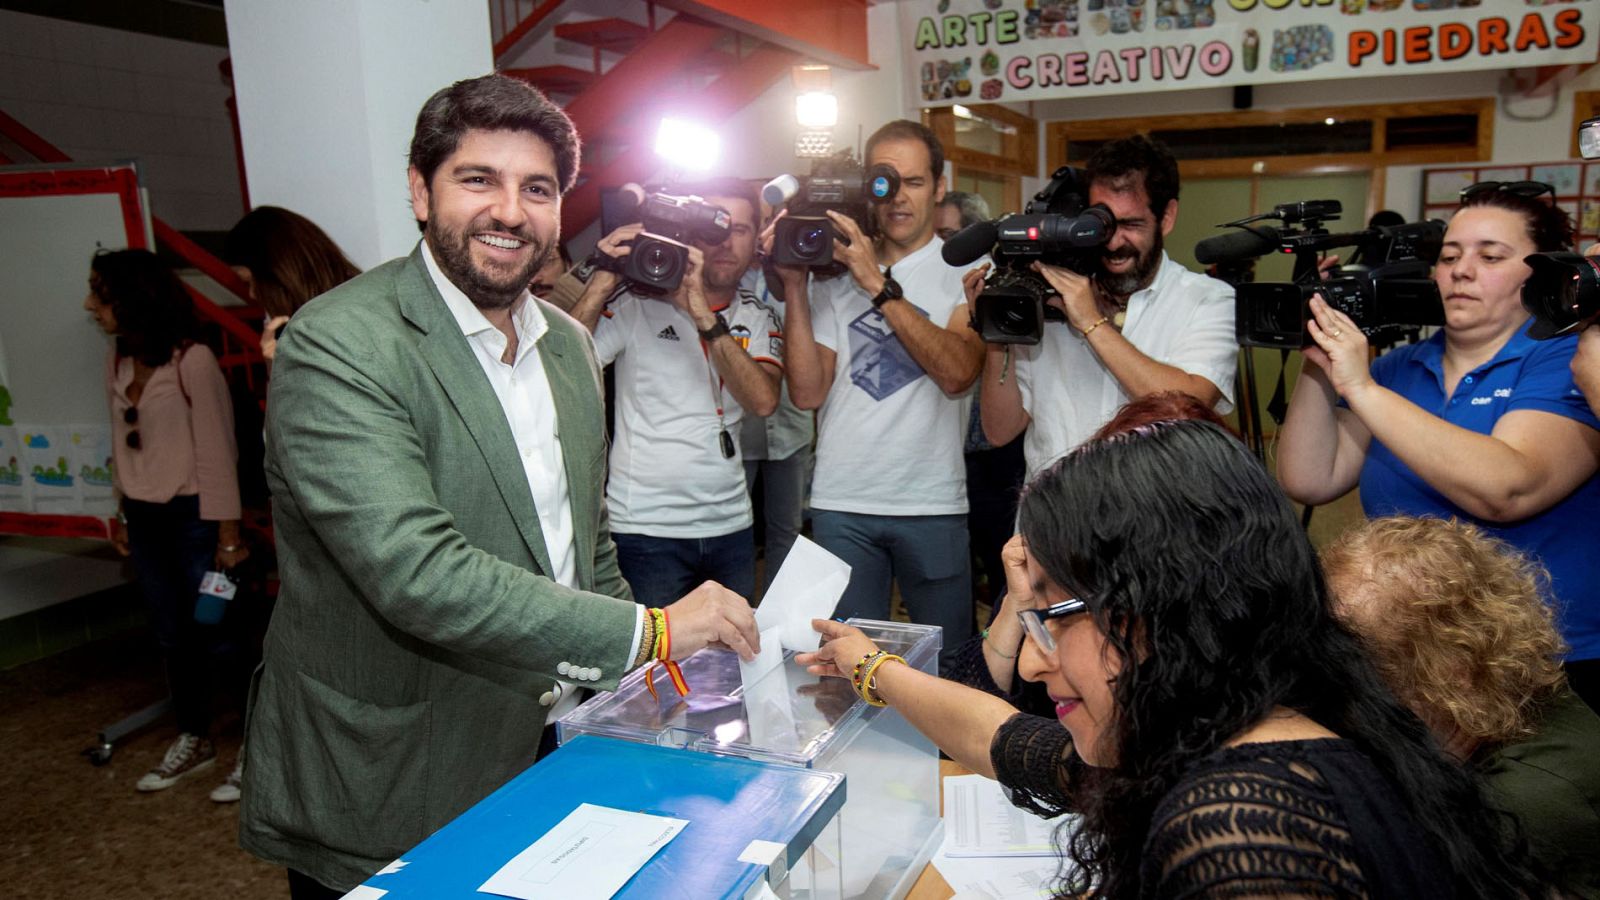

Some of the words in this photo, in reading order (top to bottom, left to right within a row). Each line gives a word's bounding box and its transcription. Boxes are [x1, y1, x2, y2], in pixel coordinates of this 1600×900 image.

[915, 10, 1020, 49] ARTE
[1006, 40, 1233, 89] CREATIVO
[1347, 9, 1585, 67] PIEDRAS
